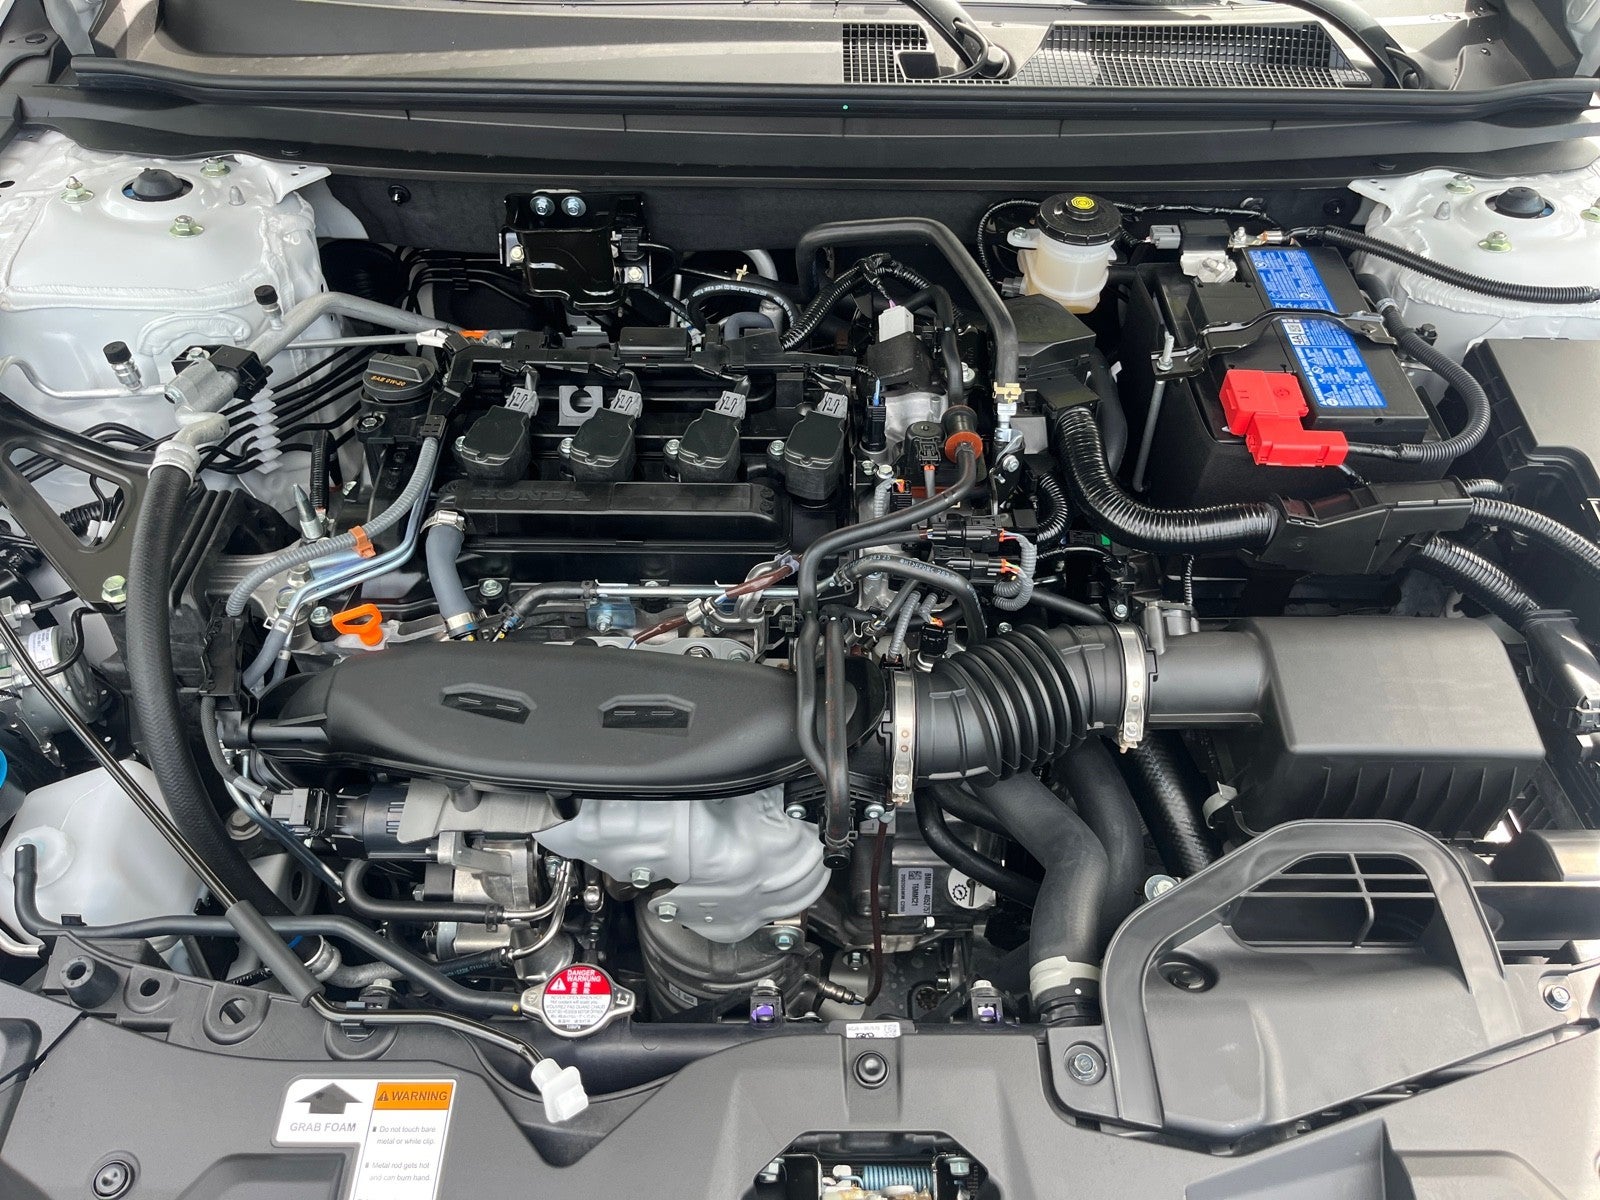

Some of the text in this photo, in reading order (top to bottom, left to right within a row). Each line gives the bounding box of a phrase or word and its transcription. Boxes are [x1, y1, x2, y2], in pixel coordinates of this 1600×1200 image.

[472, 488, 591, 502] HONDA
[392, 1091, 448, 1101] WARNING
[290, 1122, 356, 1132] GRAB FOAM
[379, 1125, 436, 1133] Do not touch bare
[376, 1137, 395, 1145] metal
[404, 1137, 421, 1145] white
[371, 1161, 430, 1171] Metal rod gets hot
[369, 1173, 382, 1181] and
